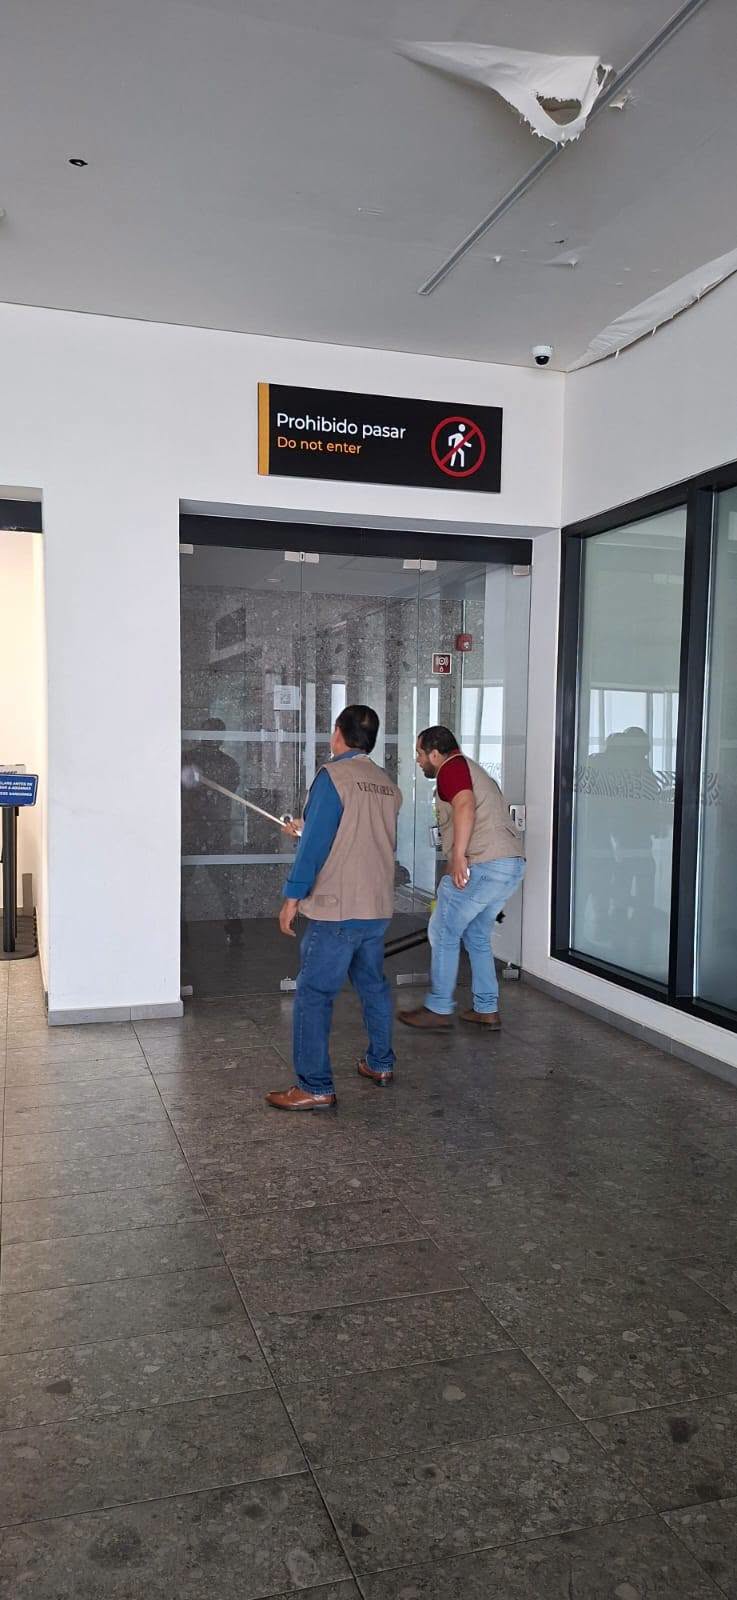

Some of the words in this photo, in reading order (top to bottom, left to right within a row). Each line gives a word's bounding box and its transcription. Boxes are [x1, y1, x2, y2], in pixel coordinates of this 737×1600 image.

[276, 412, 358, 435] Prohibido
[362, 423, 407, 440] pasar
[277, 436, 297, 449] Do
[300, 440, 323, 451] not
[326, 442, 362, 454] enter
[356, 781, 396, 797] VECTORES
